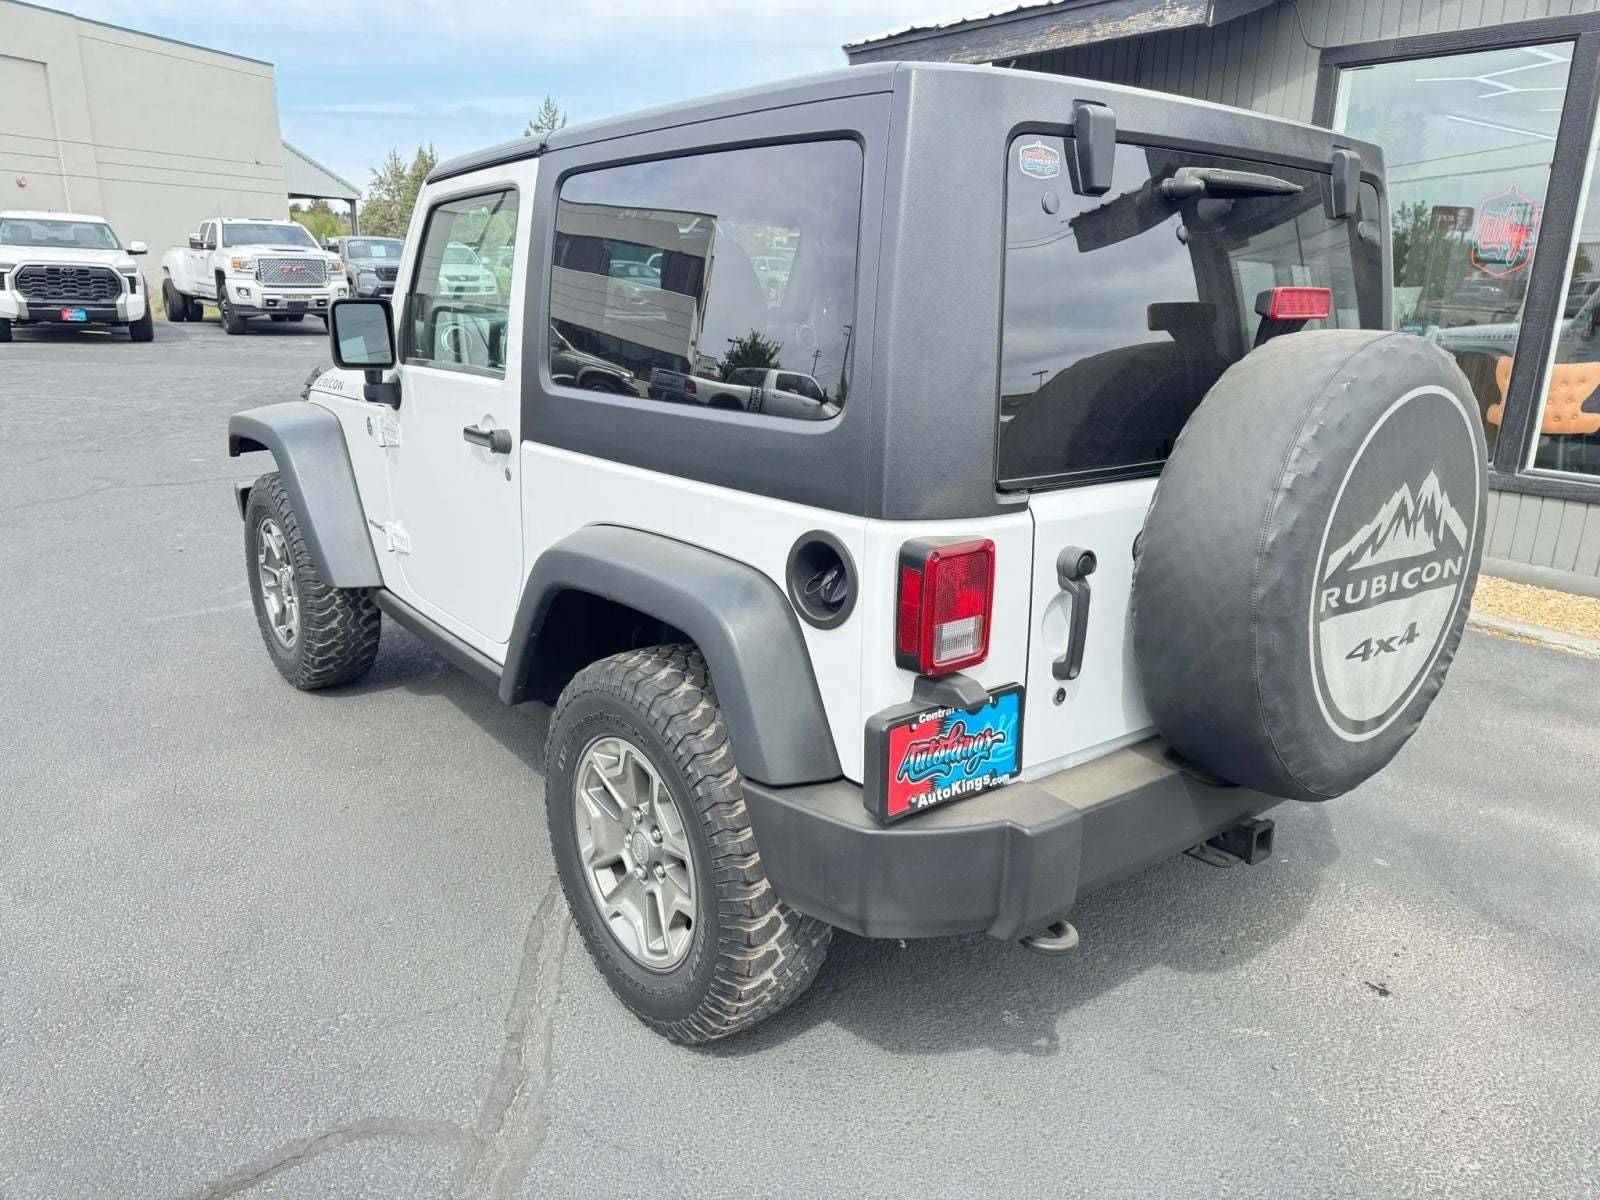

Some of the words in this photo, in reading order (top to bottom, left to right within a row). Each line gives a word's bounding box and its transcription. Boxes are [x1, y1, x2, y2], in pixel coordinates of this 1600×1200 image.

[1319, 556, 1463, 613] RUBICON
[1345, 621, 1420, 663] 4x4
[919, 707, 955, 723] Central
[917, 774, 1010, 809] AutoKings.com
